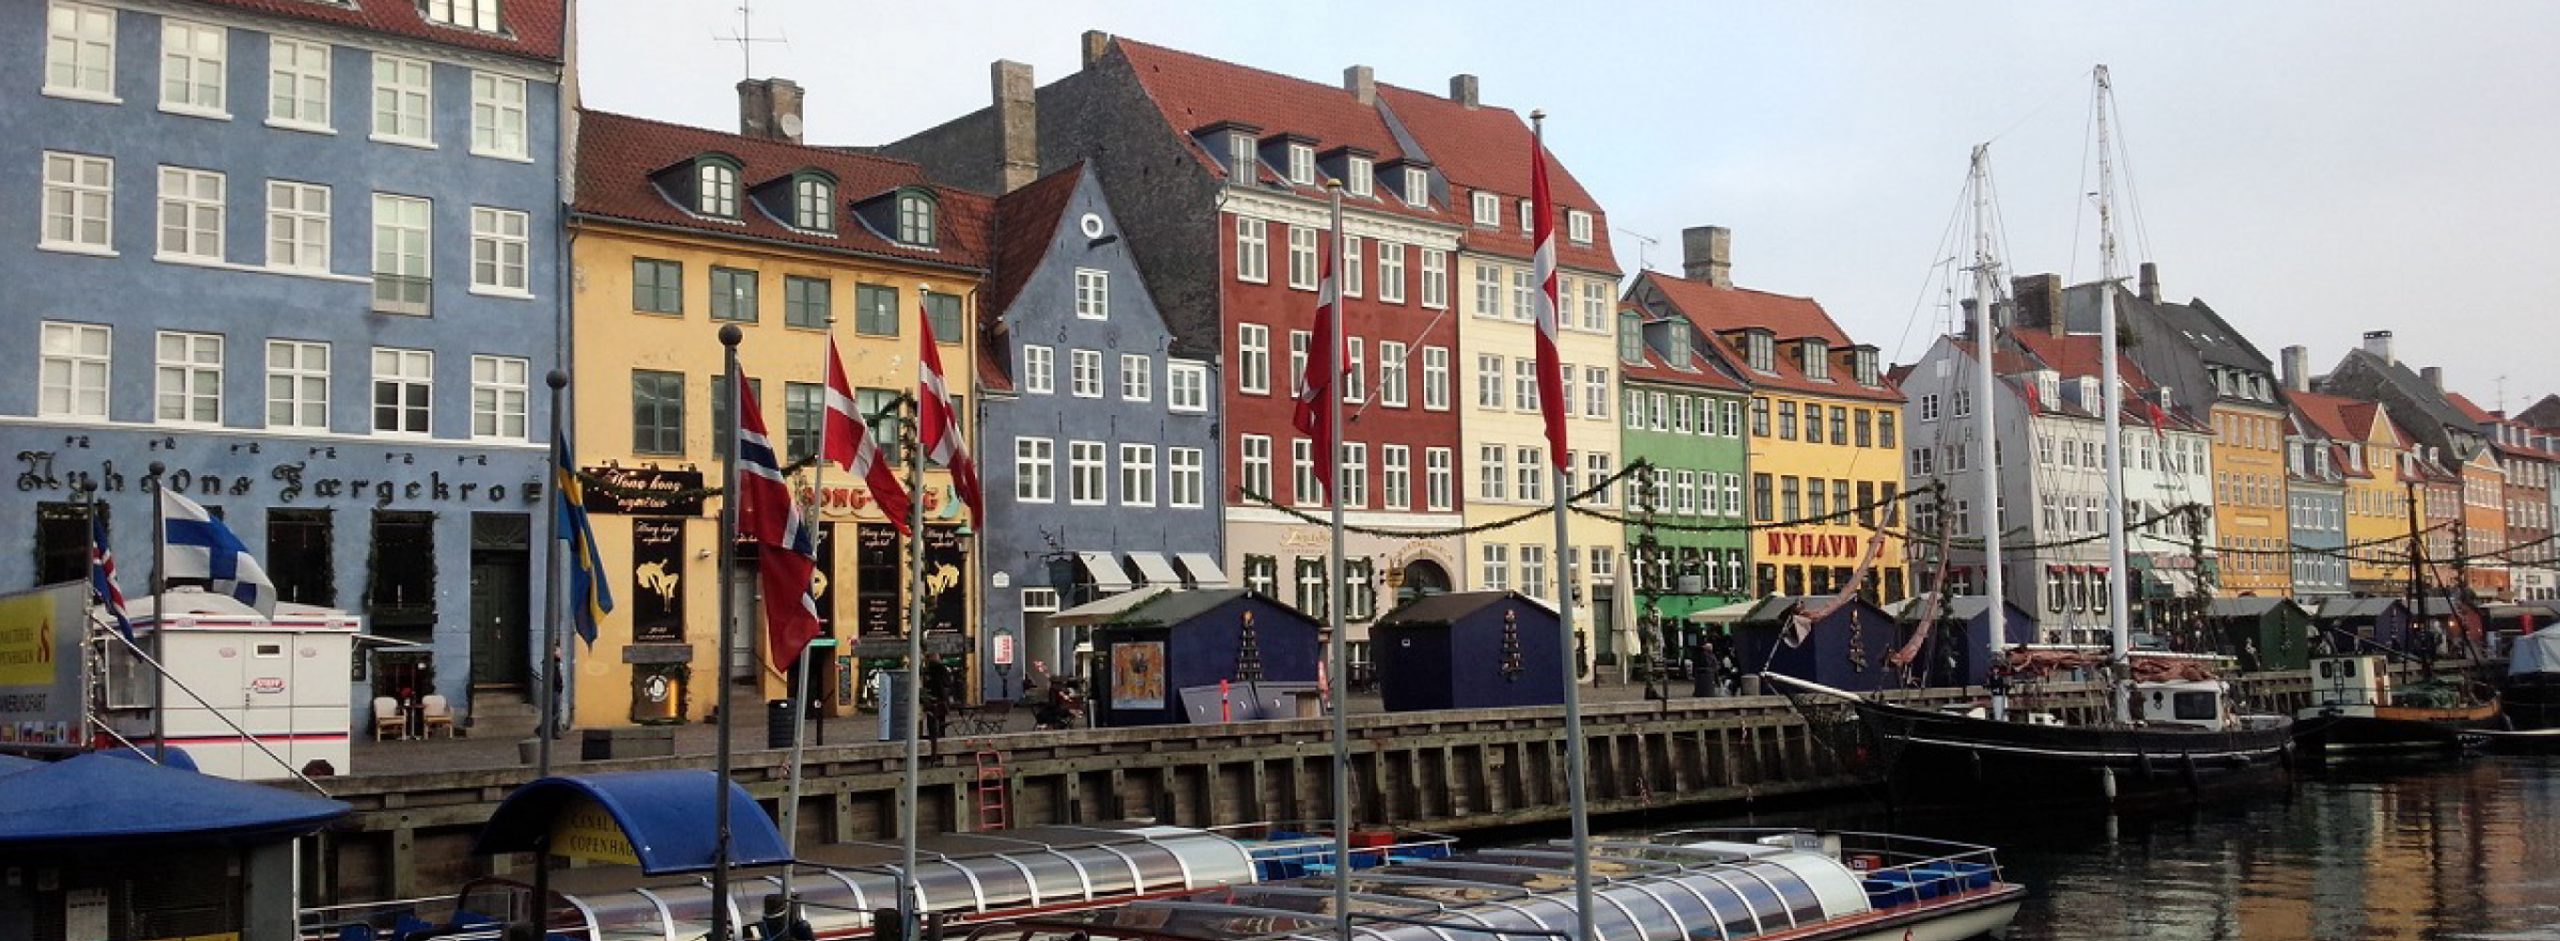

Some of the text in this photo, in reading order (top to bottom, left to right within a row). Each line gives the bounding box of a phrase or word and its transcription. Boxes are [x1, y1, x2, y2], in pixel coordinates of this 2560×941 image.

[271, 460, 505, 509] Færgekro
[1767, 531, 1858, 558] NYHAVN
[570, 834, 636, 858] COPENHAG
